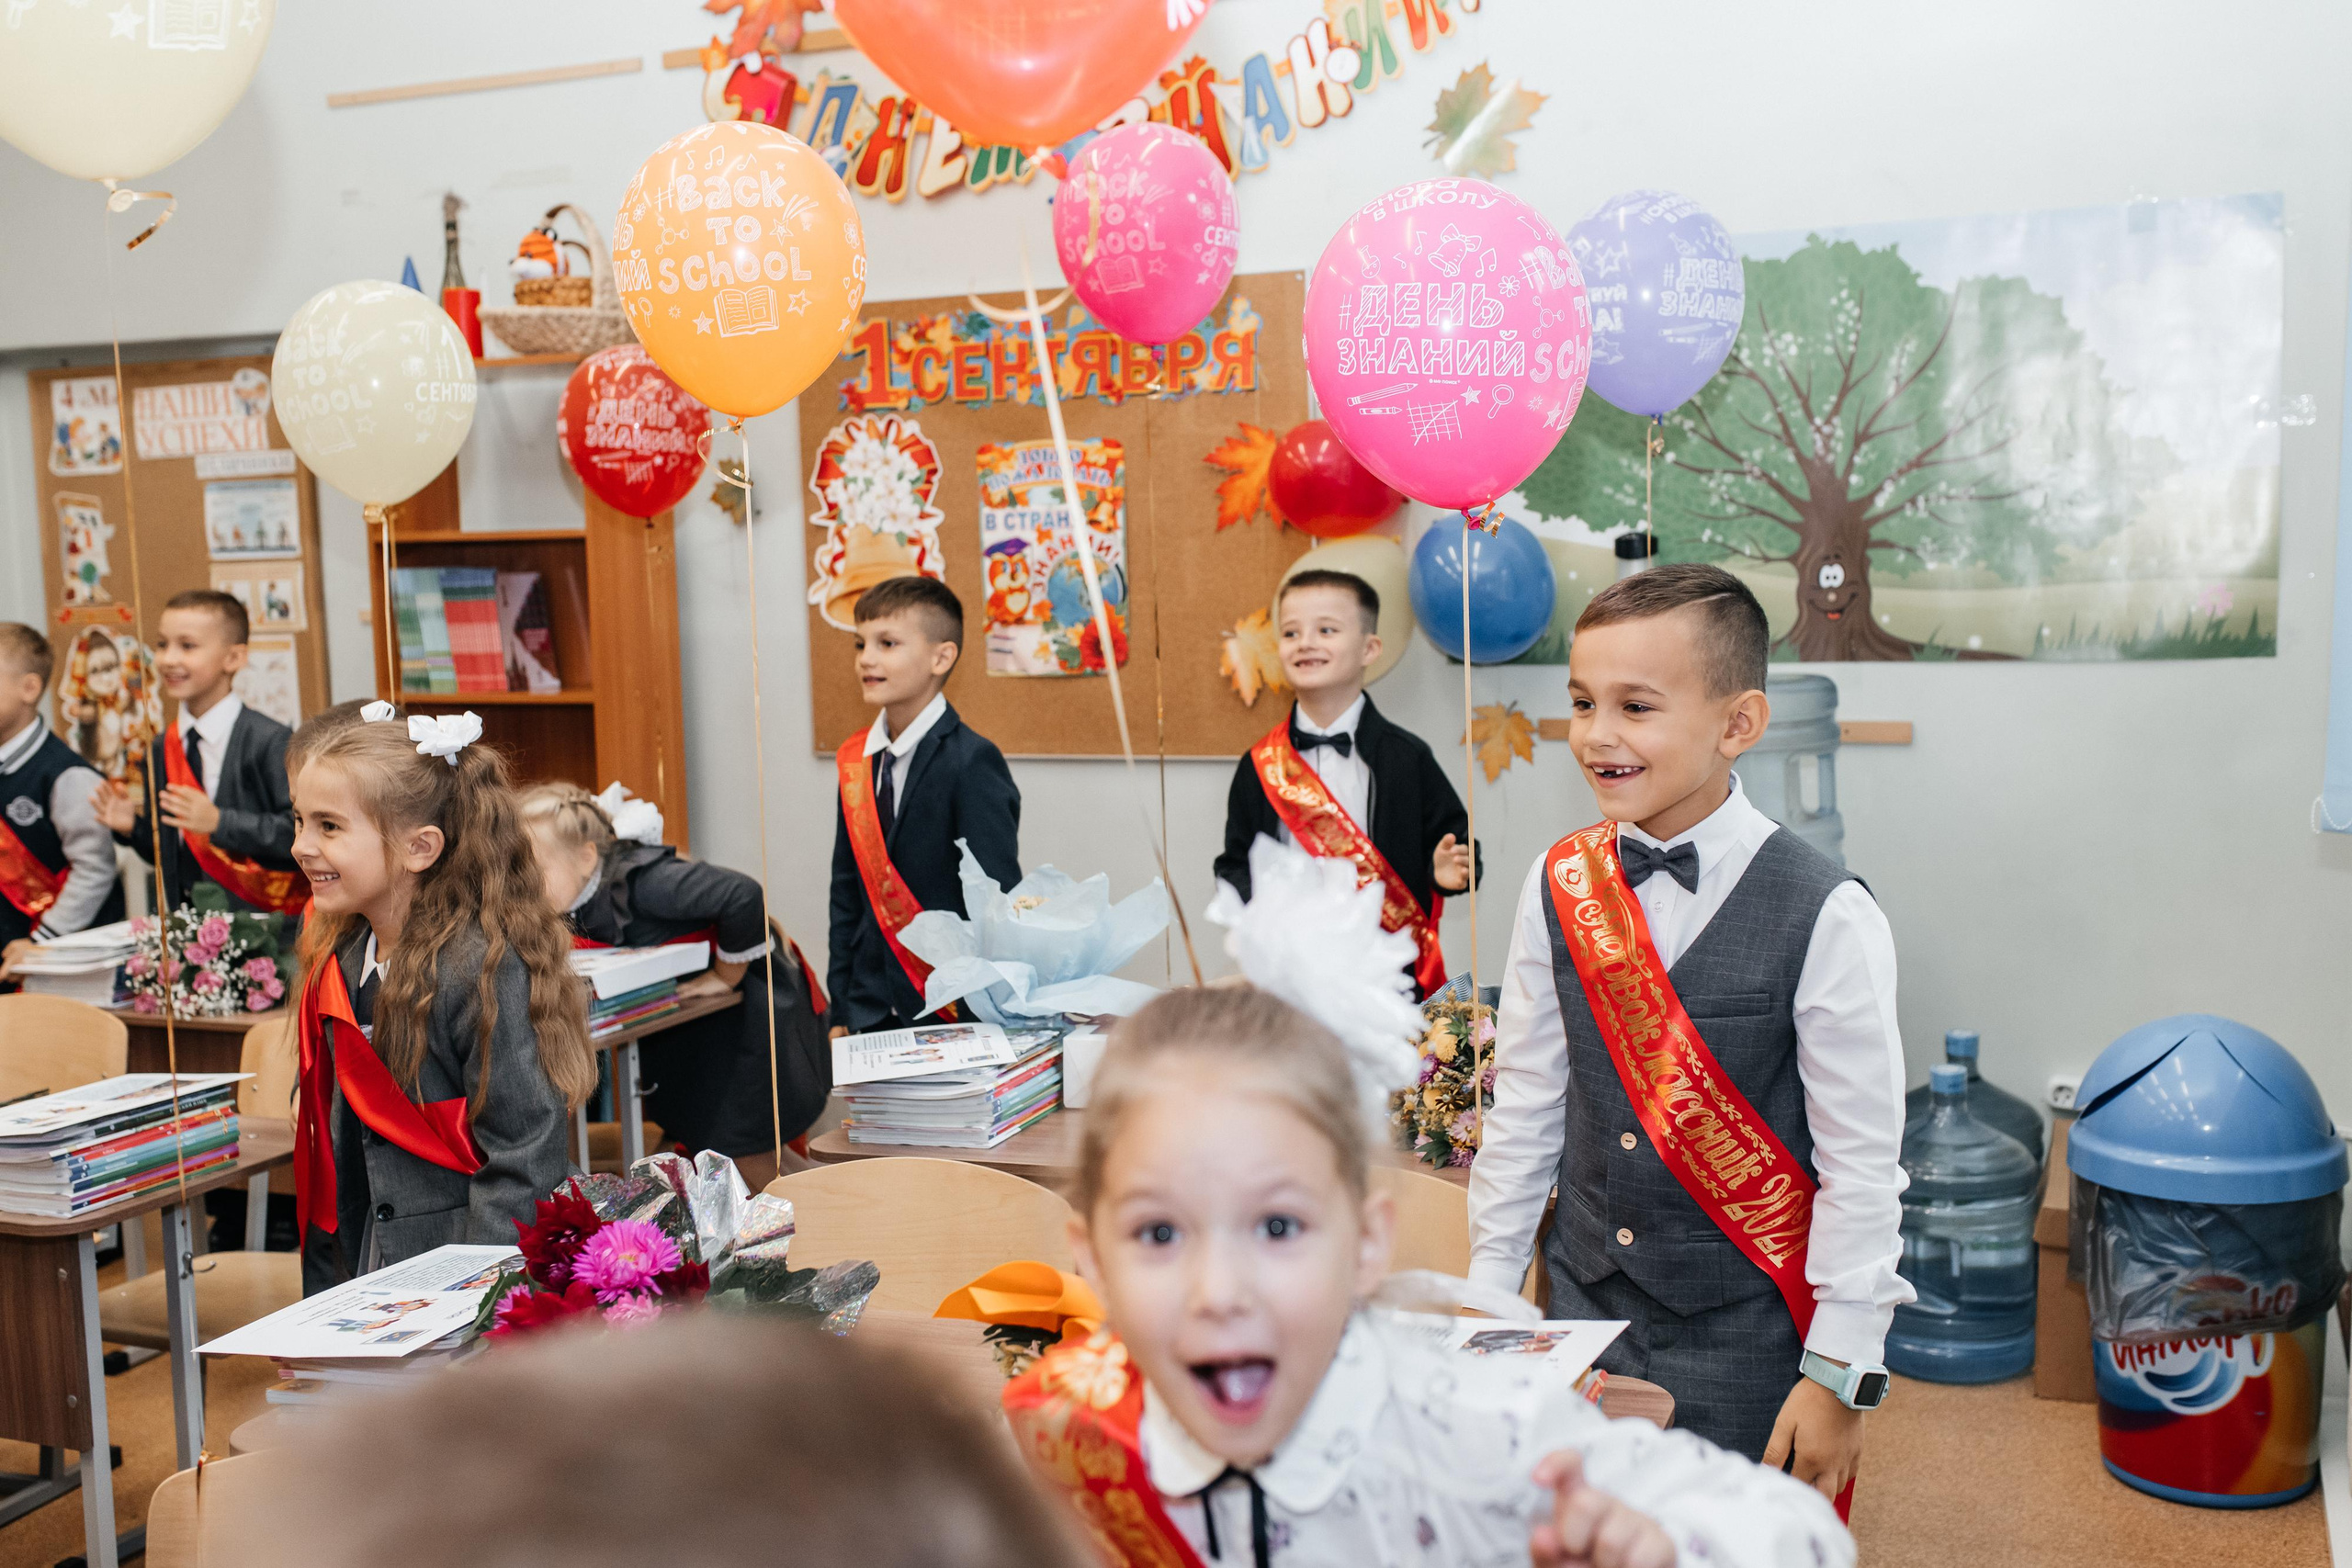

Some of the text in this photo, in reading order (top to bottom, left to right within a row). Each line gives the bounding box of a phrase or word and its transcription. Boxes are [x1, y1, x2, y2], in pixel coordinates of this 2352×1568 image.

[1095, 0, 1482, 182] НАНИ
[707, 215, 762, 245] TO
[1519, 245, 1588, 290] #Ba
[1339, 282, 1505, 337] #ДЕНЬ
[1657, 290, 1745, 322] ЗНАН
[853, 317, 908, 408] 1
[1337, 330, 1525, 377] ЗНАНИЙ
[1018, 448, 1084, 464] ДОБО
[986, 511, 1071, 531] В СТРАН
[1721, 1173, 1814, 1269] 2021
